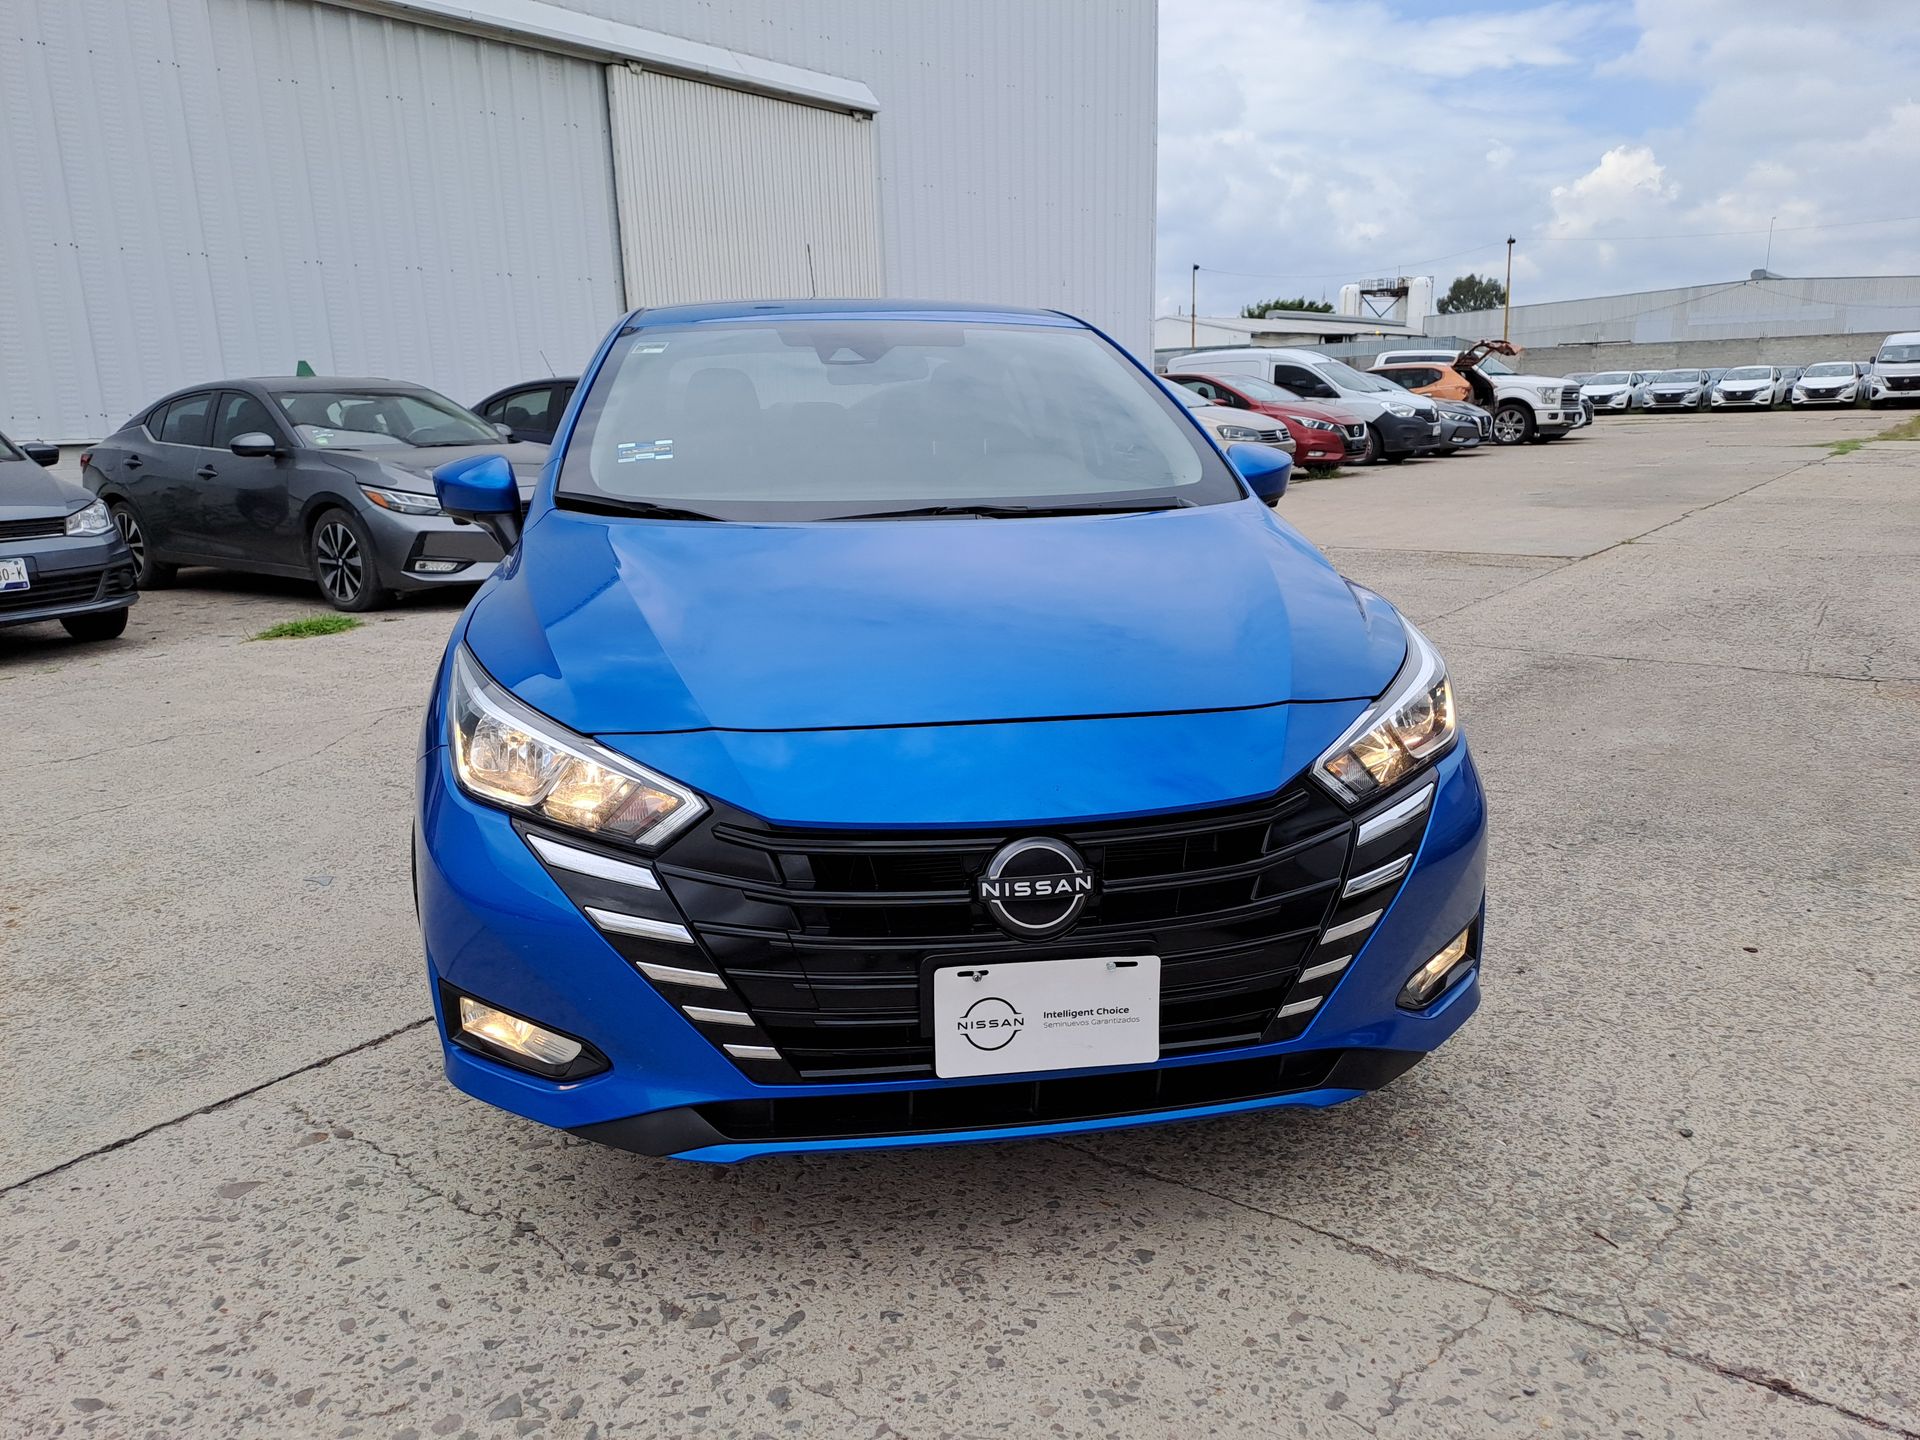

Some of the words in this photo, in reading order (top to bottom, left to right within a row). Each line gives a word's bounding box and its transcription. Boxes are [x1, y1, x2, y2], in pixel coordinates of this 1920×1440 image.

[981, 875, 1091, 897] NISSAN
[1043, 1008, 1094, 1019] Intelligent
[1096, 1006, 1130, 1015] Choice
[957, 1017, 1024, 1030] NISSAN
[1043, 1019, 1089, 1028] Seminuevos
[1090, 1016, 1140, 1026] Garantizados
